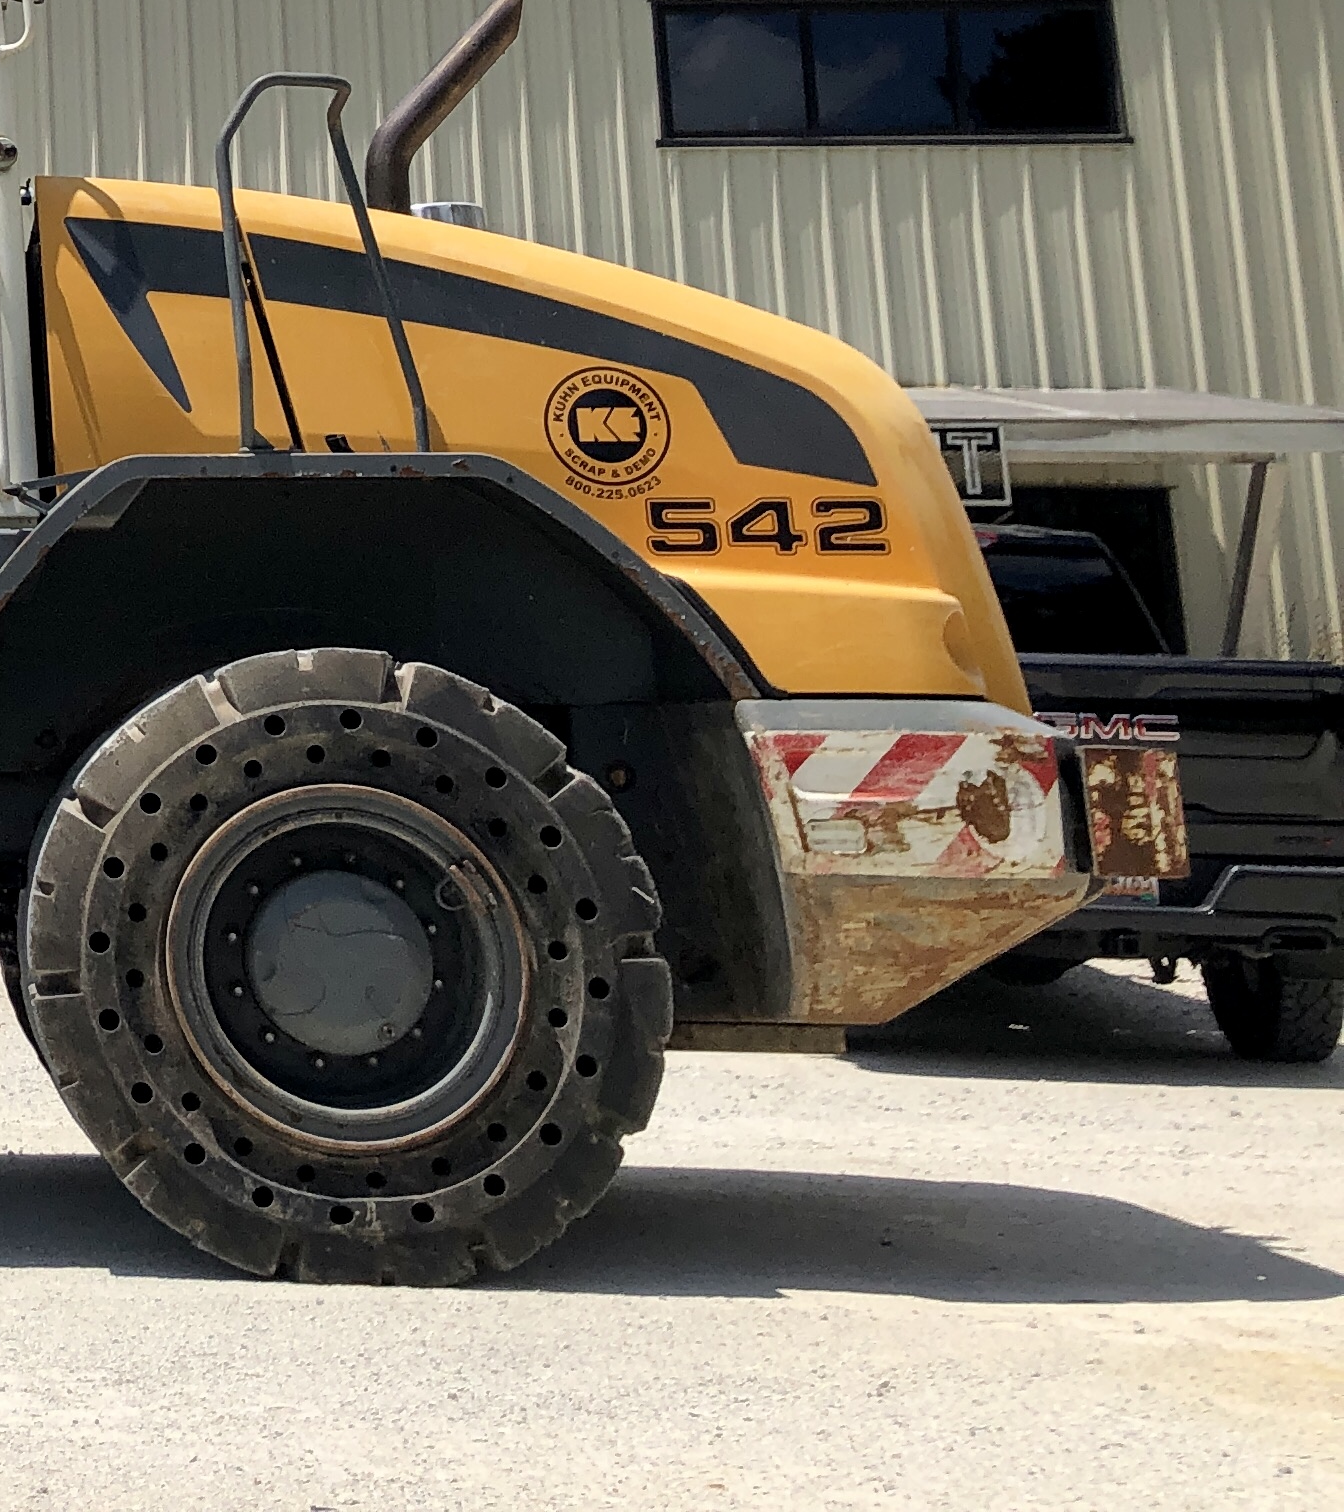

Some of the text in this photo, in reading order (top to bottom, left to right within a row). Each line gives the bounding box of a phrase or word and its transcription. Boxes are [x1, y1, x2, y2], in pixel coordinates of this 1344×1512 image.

[553, 374, 662, 422] KUHN EQUIPMENT
[564, 447, 657, 479] SCRAP & DEMO
[565, 475, 662, 500] 800.225.0623
[645, 497, 892, 556] 542
[1033, 712, 1181, 741] GMC
